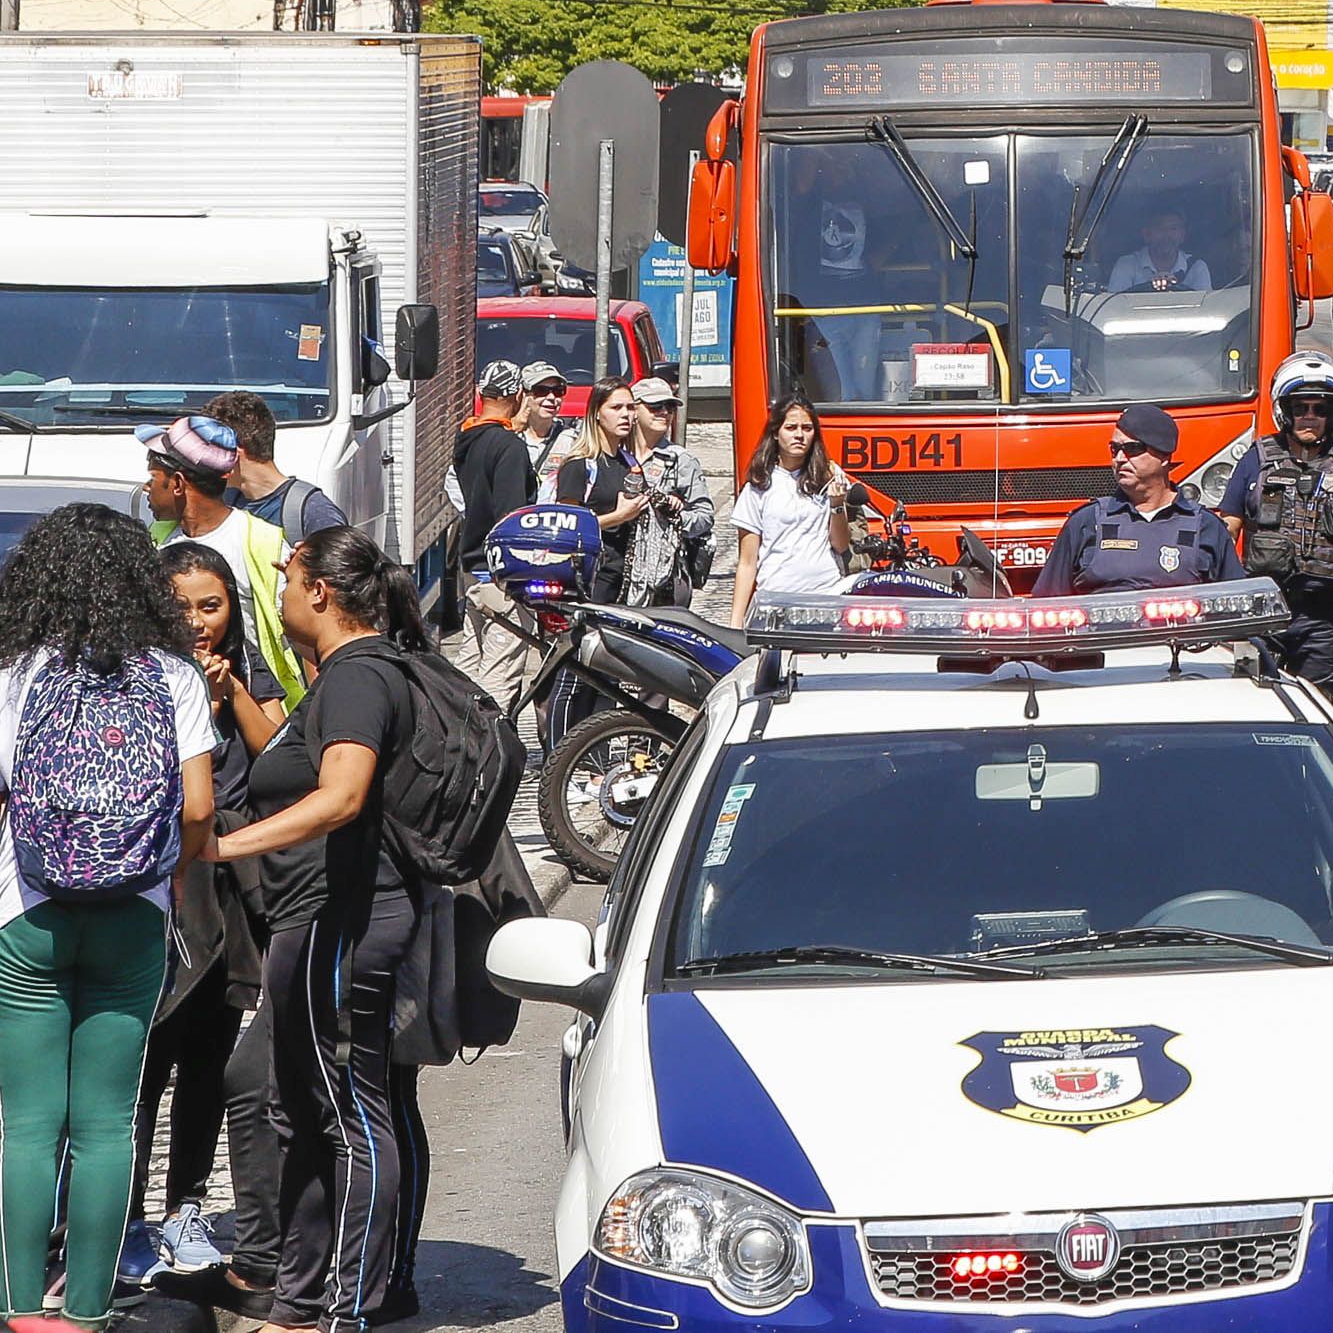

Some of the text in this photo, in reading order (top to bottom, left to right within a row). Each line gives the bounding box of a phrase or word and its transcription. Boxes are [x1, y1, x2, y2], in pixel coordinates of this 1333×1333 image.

[694, 298, 710, 311] JUL
[694, 311, 710, 323] AGO
[841, 432, 963, 470] BD141
[520, 512, 577, 531] GTM
[1003, 1033, 1137, 1047] MUNICIPAL
[1020, 1029, 1113, 1040] GUARDA
[1029, 1107, 1136, 1123] CURITIBA
[1072, 1233, 1106, 1263] FIAT
